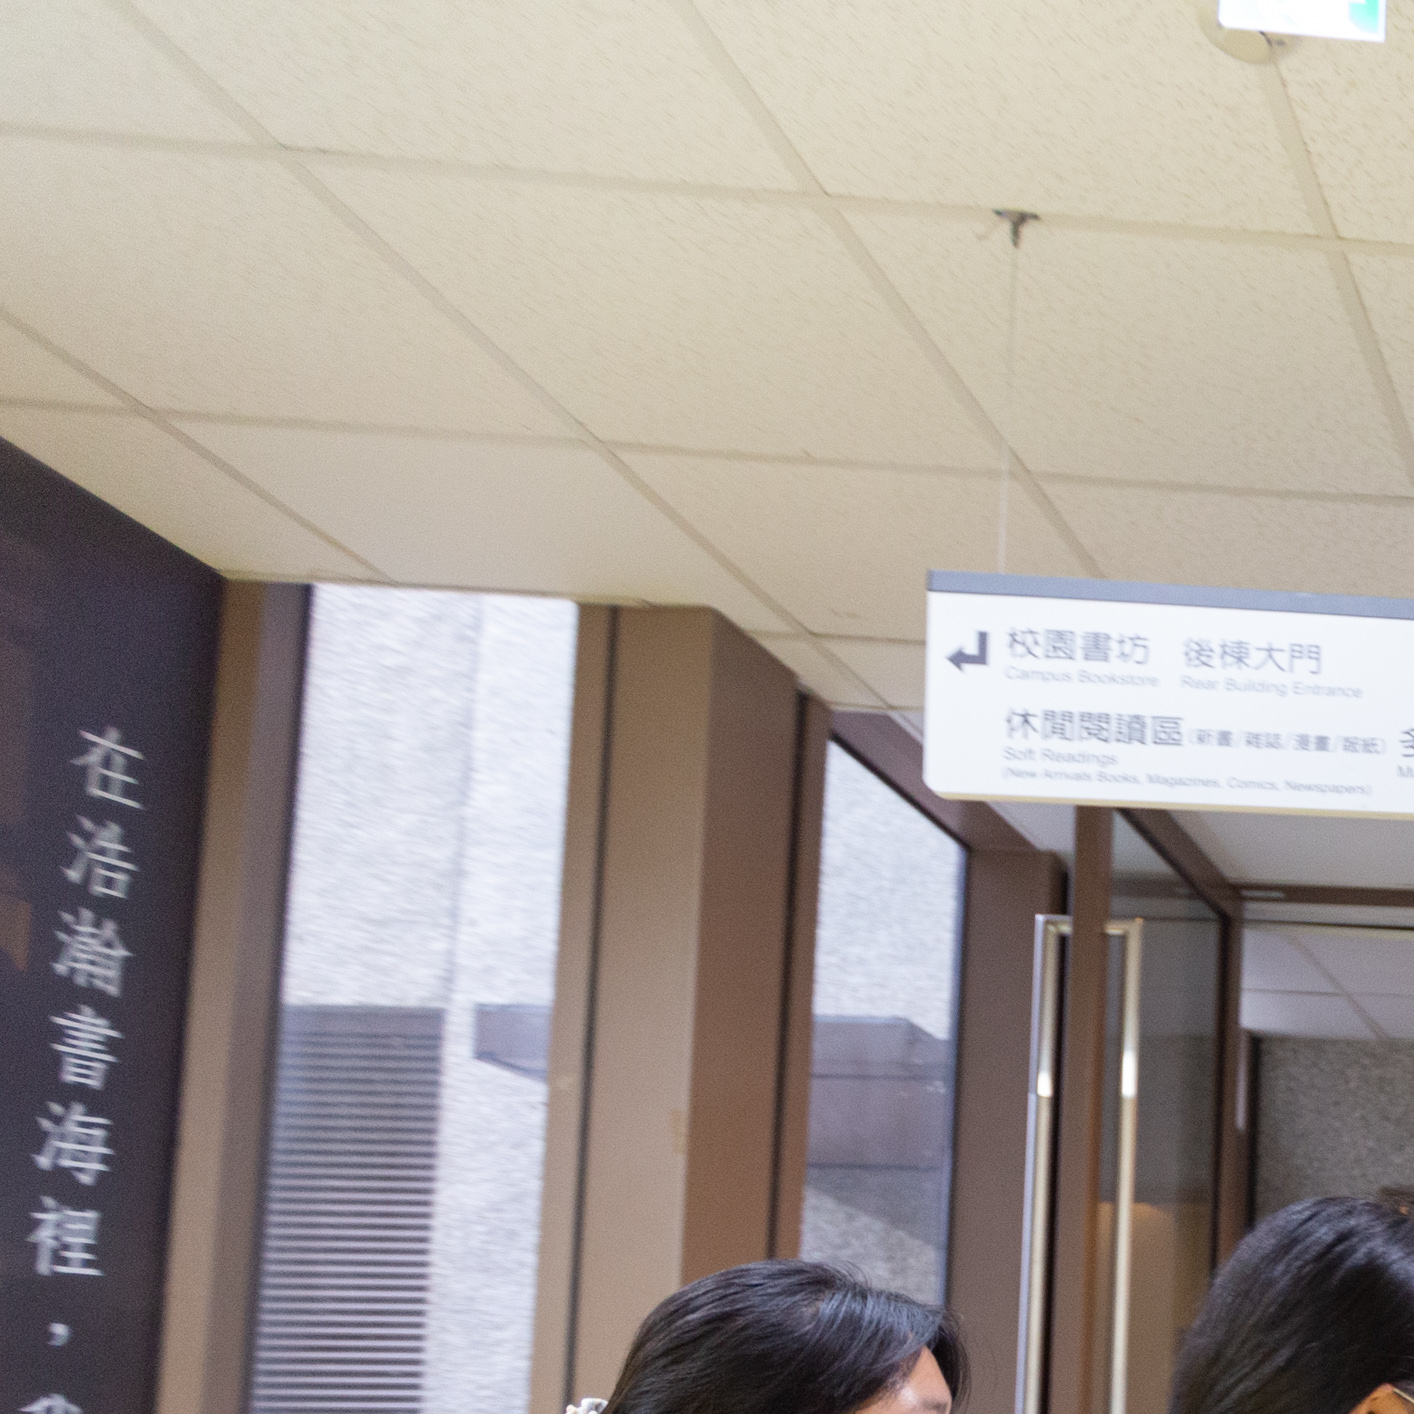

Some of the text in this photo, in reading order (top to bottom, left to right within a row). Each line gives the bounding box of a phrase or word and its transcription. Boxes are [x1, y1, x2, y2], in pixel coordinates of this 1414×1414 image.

[1007, 627, 1322, 675] 校園書坊 後棟大門
[1004, 665, 1160, 688] Campus Bookstore
[1180, 675, 1363, 698] Rear Building Entrance
[1003, 745, 1119, 768] Soft Readings
